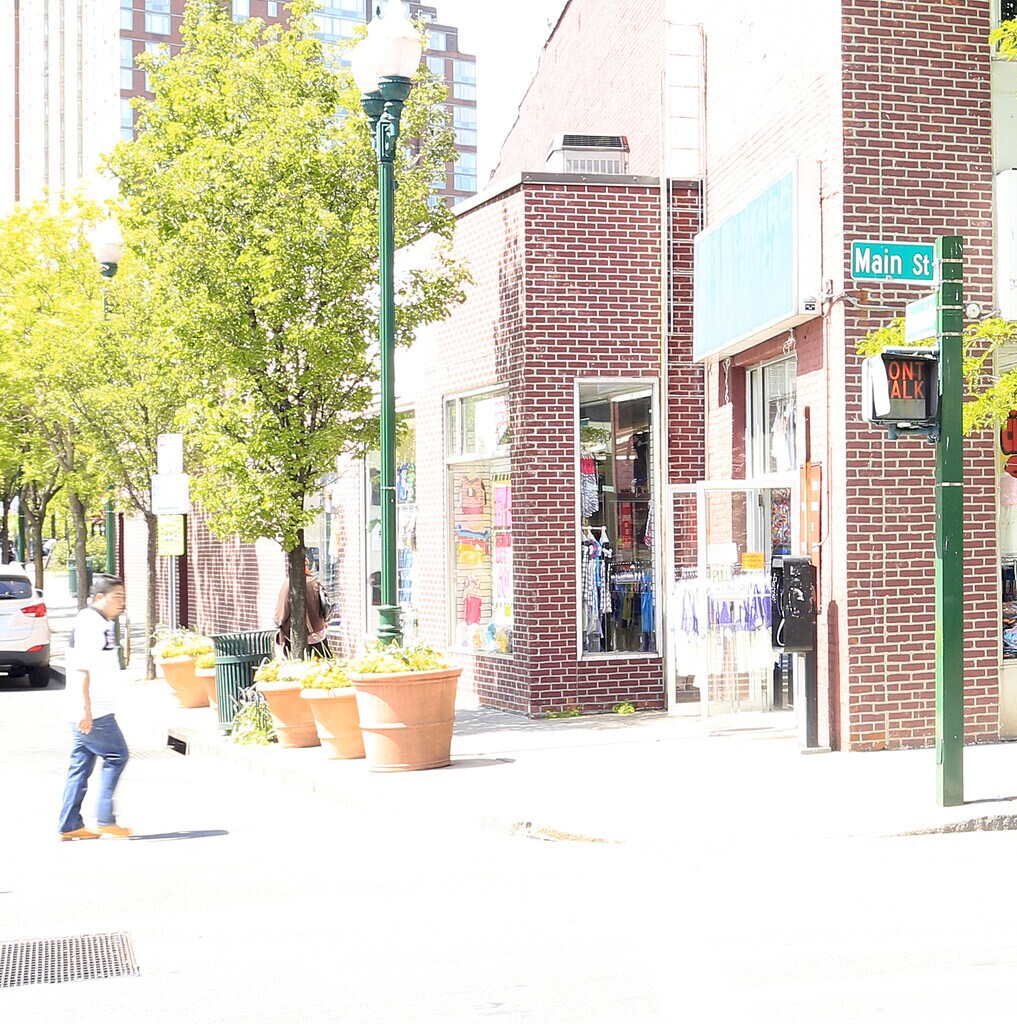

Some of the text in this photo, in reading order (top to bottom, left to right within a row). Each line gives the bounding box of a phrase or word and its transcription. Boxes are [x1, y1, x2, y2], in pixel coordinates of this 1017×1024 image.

[855, 247, 930, 276] Main St
[889, 361, 924, 380] ONT
[890, 380, 925, 399] ALK
